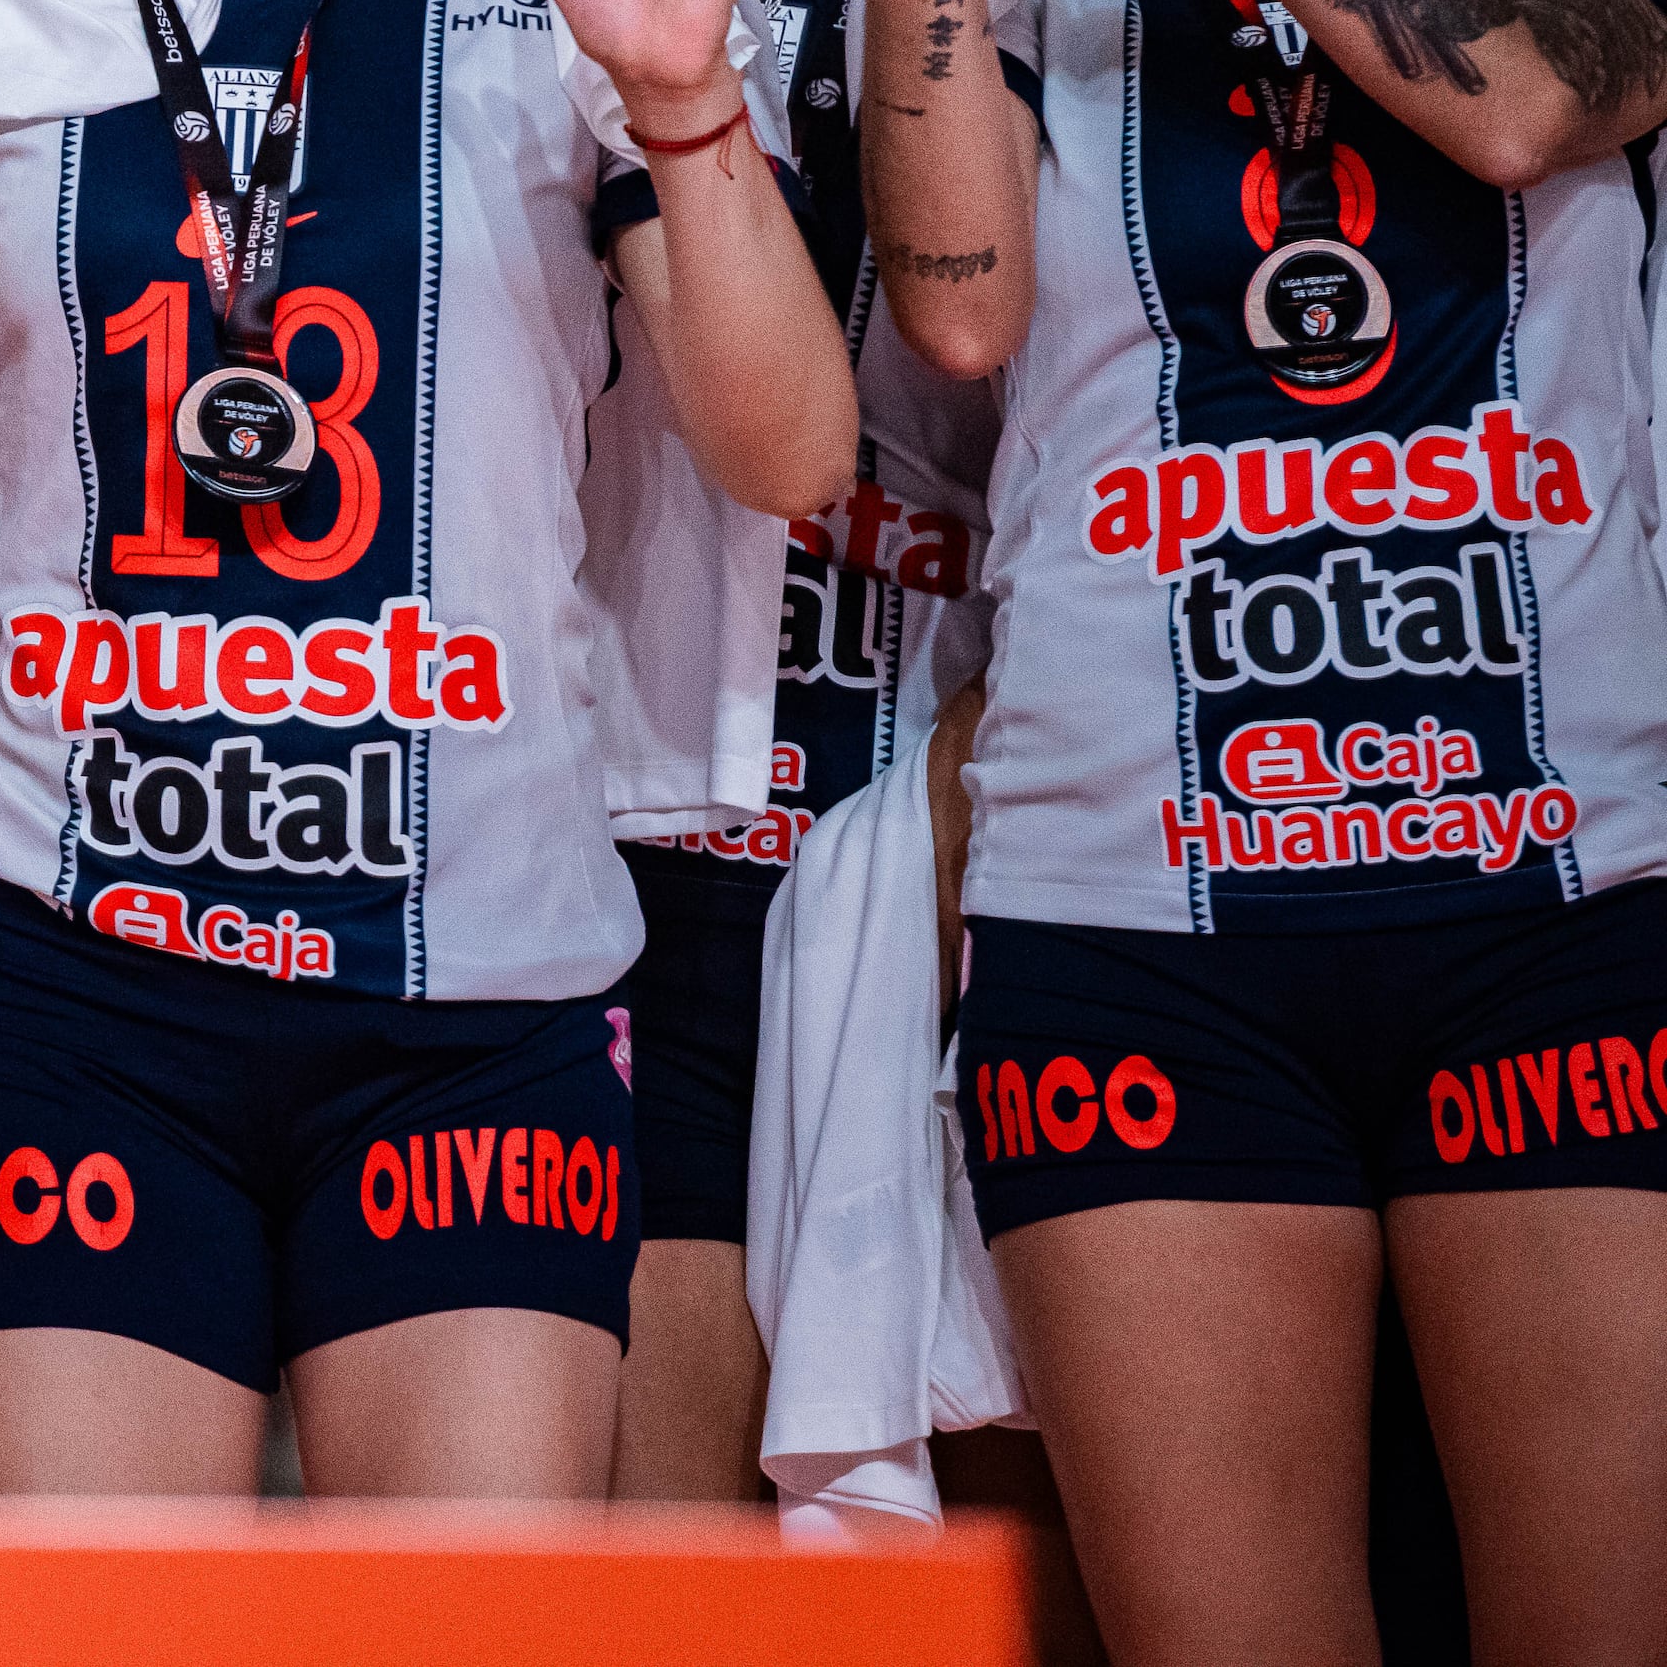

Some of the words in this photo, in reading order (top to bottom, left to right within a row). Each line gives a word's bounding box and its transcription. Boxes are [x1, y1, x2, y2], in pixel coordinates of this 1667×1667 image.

[451, 5, 552, 31] HYUN
[209, 70, 284, 85] ALIANZ
[197, 190, 221, 255] PERUANA
[246, 184, 267, 249] PERUANA
[261, 199, 281, 246] VÓLEY
[211, 256, 229, 290] LIGA
[241, 250, 259, 283] LIGA
[259, 247, 275, 267] DE
[104, 281, 381, 581] 18
[213, 398, 235, 408] LIGA
[236, 400, 280, 415] PERUANA
[224, 409, 238, 419] DE
[1089, 406, 1593, 575] apuesta
[1180, 543, 1523, 683] total
[9, 604, 505, 733] apuesta
[1339, 717, 1479, 795] Caja
[82, 743, 408, 872] total
[1162, 784, 1578, 870] Huancayo
[202, 910, 332, 980] Caja
[976, 1054, 1177, 1161] SACO
[359, 1126, 620, 1242] OLIVEROS
